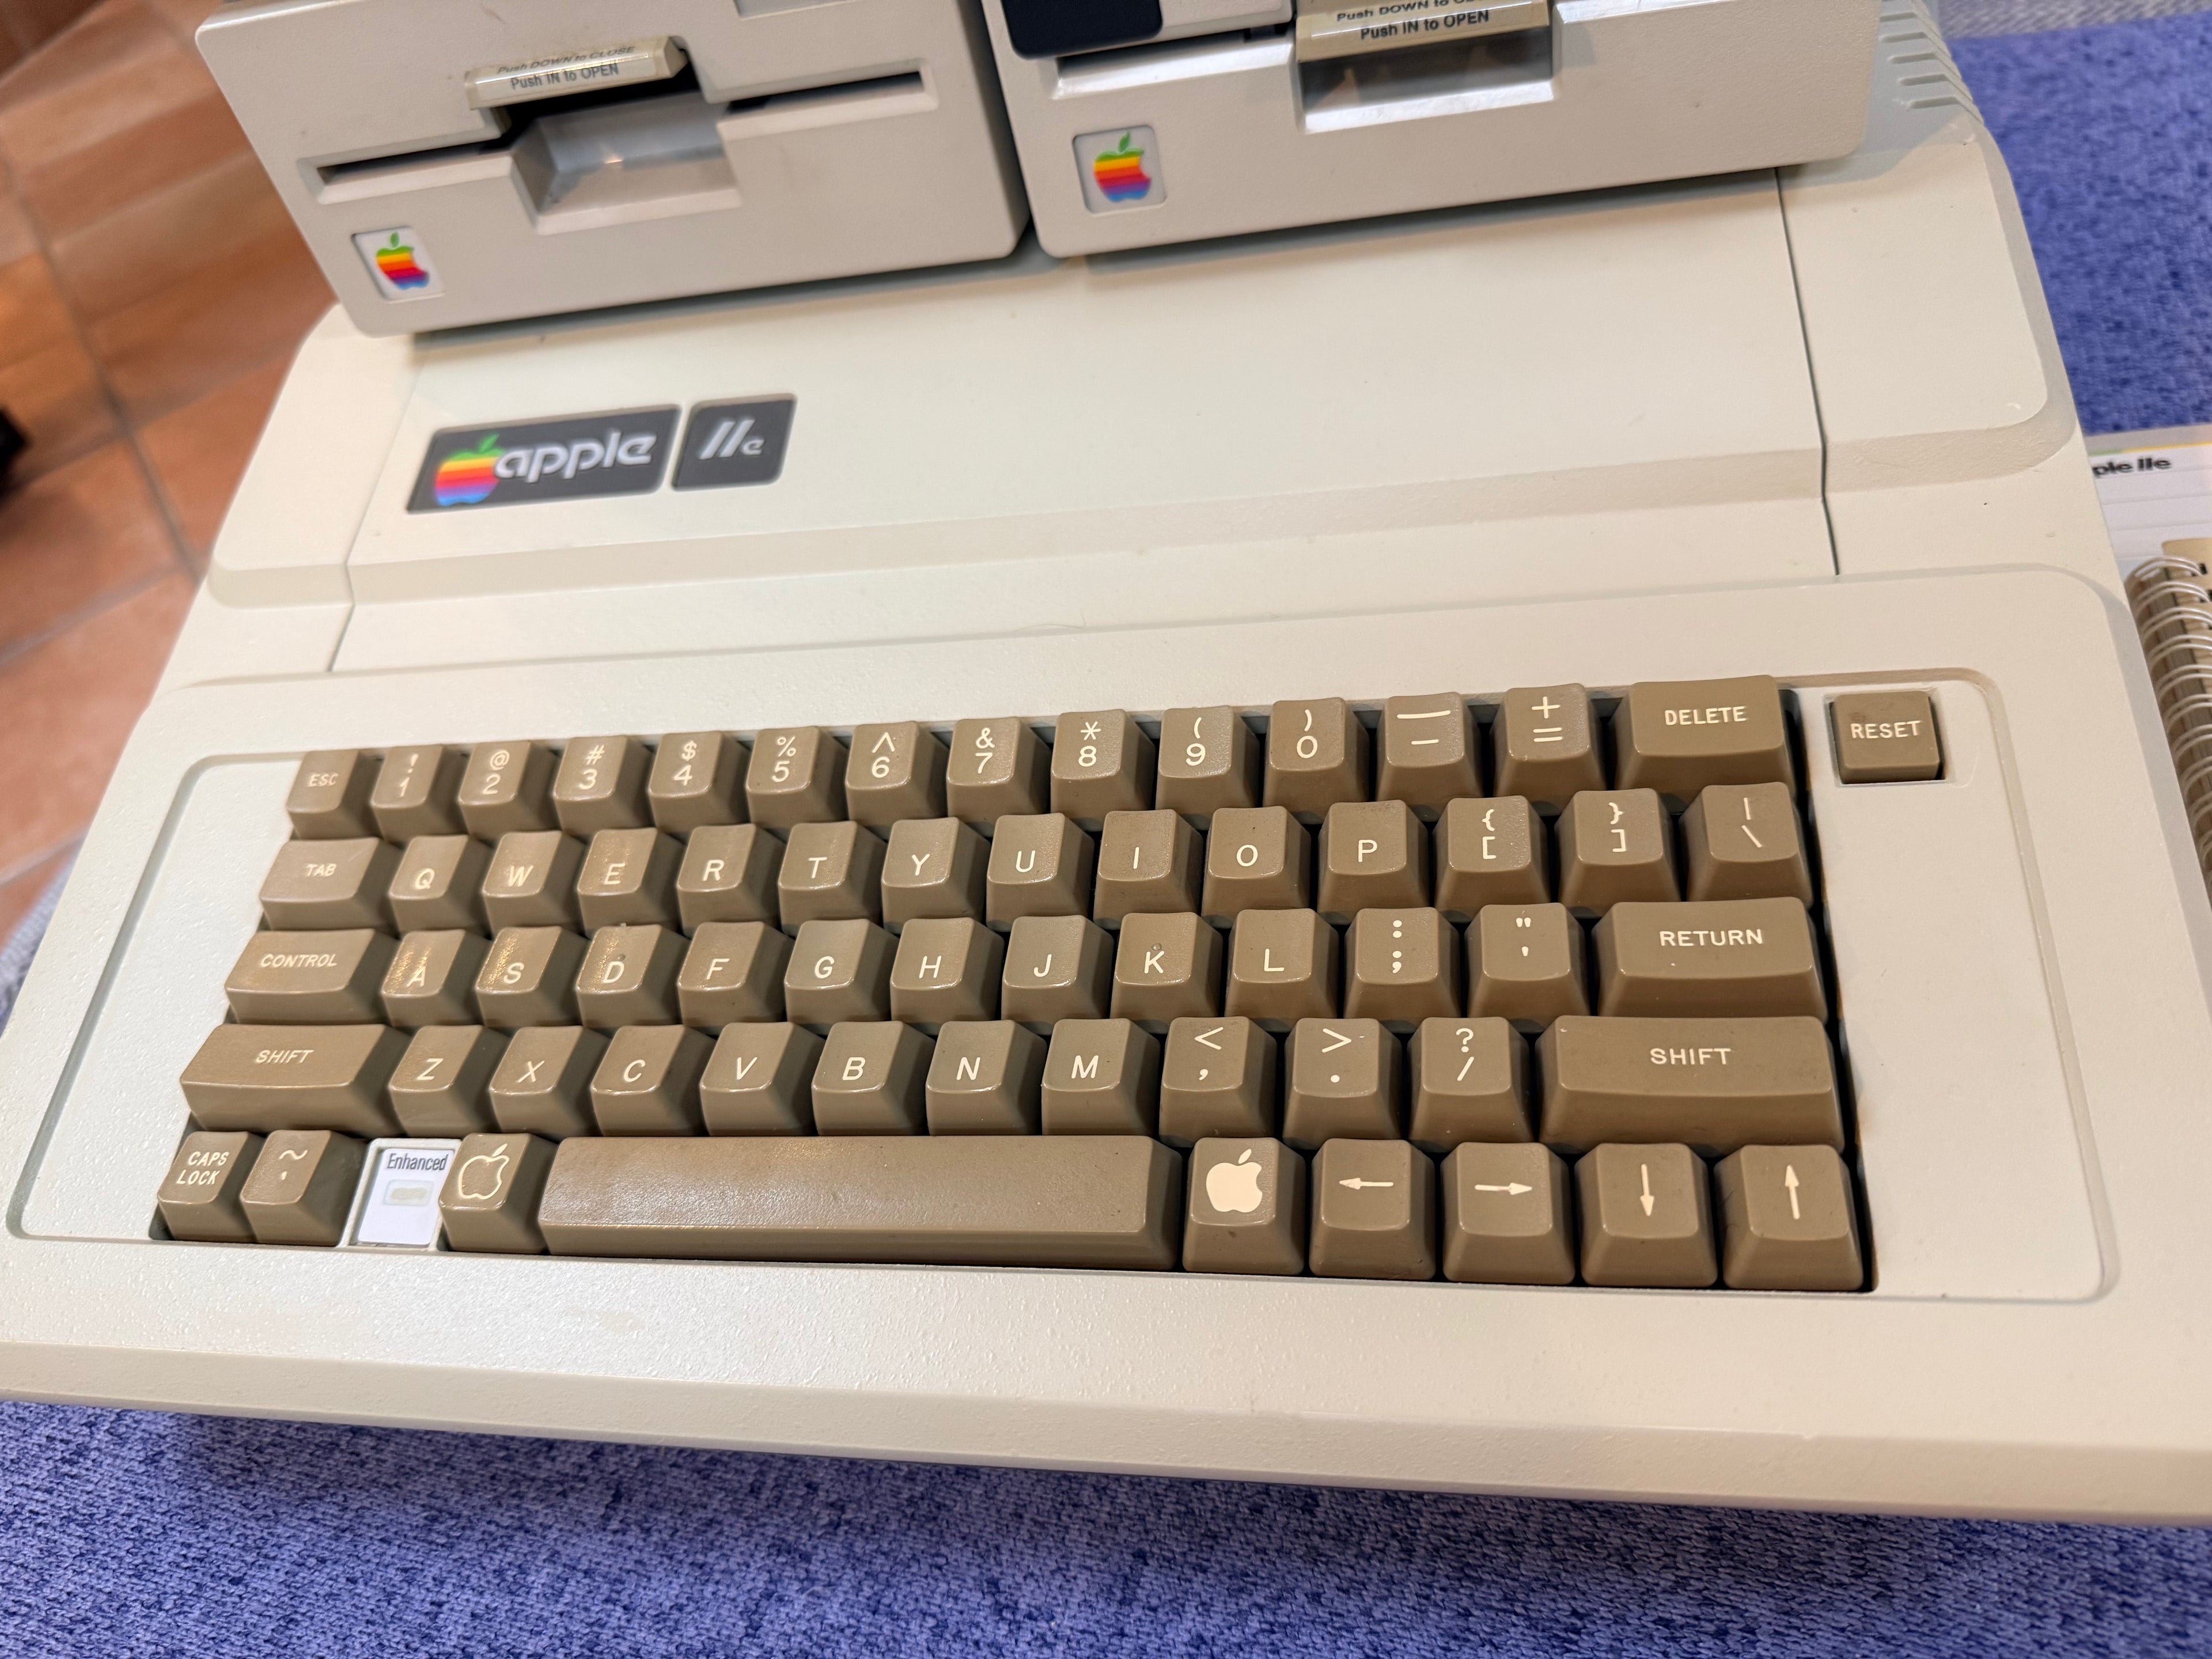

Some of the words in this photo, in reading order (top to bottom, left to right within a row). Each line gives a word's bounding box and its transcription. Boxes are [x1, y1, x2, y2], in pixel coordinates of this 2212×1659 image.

[1336, 10, 1373, 22] Push
[1379, 1, 1429, 15] DOWN
[1361, 26, 1397, 40] Push
[1403, 20, 1419, 33] IN
[1424, 18, 1440, 31] to
[1443, 10, 1490, 28] OPEN
[498, 65, 527, 74] Push
[530, 58, 573, 68] DOWN
[575, 54, 587, 62] to
[590, 47, 635, 60] CLOSE
[511, 75, 542, 89] Push
[547, 72, 560, 84] IN
[565, 69, 577, 82] to
[581, 64, 619, 79] OPEN
[495, 429, 657, 484] apple
[1531, 695, 1561, 719] +
[1664, 705, 1747, 726] DELETE
[1193, 716, 1202, 740] (
[1304, 709, 1313, 732] )
[1850, 719, 1922, 740] RESET
[776, 734, 797, 757] %
[975, 726, 996, 749] &
[1532, 726, 1563, 743] =
[488, 749, 510, 771] @
[585, 744, 605, 766] #
[681, 740, 698, 762] $
[975, 751, 994, 775] 7
[1077, 745, 1097, 768] 8
[1185, 743, 1206, 767] 9
[407, 753, 419, 774] !
[673, 764, 694, 786] 4
[771, 760, 790, 783] 5
[871, 756, 891, 779] 6
[306, 772, 339, 787] ESC
[399, 779, 410, 798] 1
[481, 772, 501, 796] 2
[577, 768, 598, 790] 3
[1481, 808, 1495, 832] {
[1608, 801, 1624, 825] }
[1357, 839, 1378, 863] P
[1482, 835, 1497, 860] [
[1610, 828, 1627, 853] ]
[808, 856, 828, 880] T
[911, 853, 931, 877] Y
[1015, 849, 1036, 873] U
[1236, 844, 1259, 868] O
[305, 862, 337, 877] TAB
[414, 868, 435, 891] Q
[507, 865, 535, 887] W
[603, 861, 626, 885] E
[702, 859, 725, 882] R
[1392, 919, 1403, 939] :
[1659, 928, 1763, 947] RETURN
[259, 953, 338, 968] CONTROL
[602, 960, 625, 984] D
[706, 957, 730, 980] F
[814, 955, 835, 979] G
[918, 955, 942, 979] H
[1033, 953, 1052, 978] J
[1143, 950, 1165, 975] K
[1263, 948, 1285, 972] L
[1392, 950, 1403, 974] ;
[406, 965, 427, 988] A
[503, 961, 525, 984] S
[1194, 1026, 1224, 1051] <
[1321, 1028, 1353, 1054] >
[1455, 1027, 1474, 1053] ?
[255, 1049, 315, 1064] SHIFT
[736, 1056, 758, 1081] V
[842, 1056, 866, 1081] B
[956, 1056, 982, 1081] N
[1070, 1054, 1100, 1080] M
[1649, 1047, 1732, 1066] SHIFT
[415, 1058, 444, 1081] Z
[516, 1060, 546, 1084] X
[623, 1059, 646, 1083] C
[1456, 1056, 1475, 1082] /
[187, 1150, 230, 1167] CAPS
[278, 1149, 308, 1161] ~
[387, 1153, 449, 1171] Enhanced
[175, 1169, 221, 1186] LOCK
